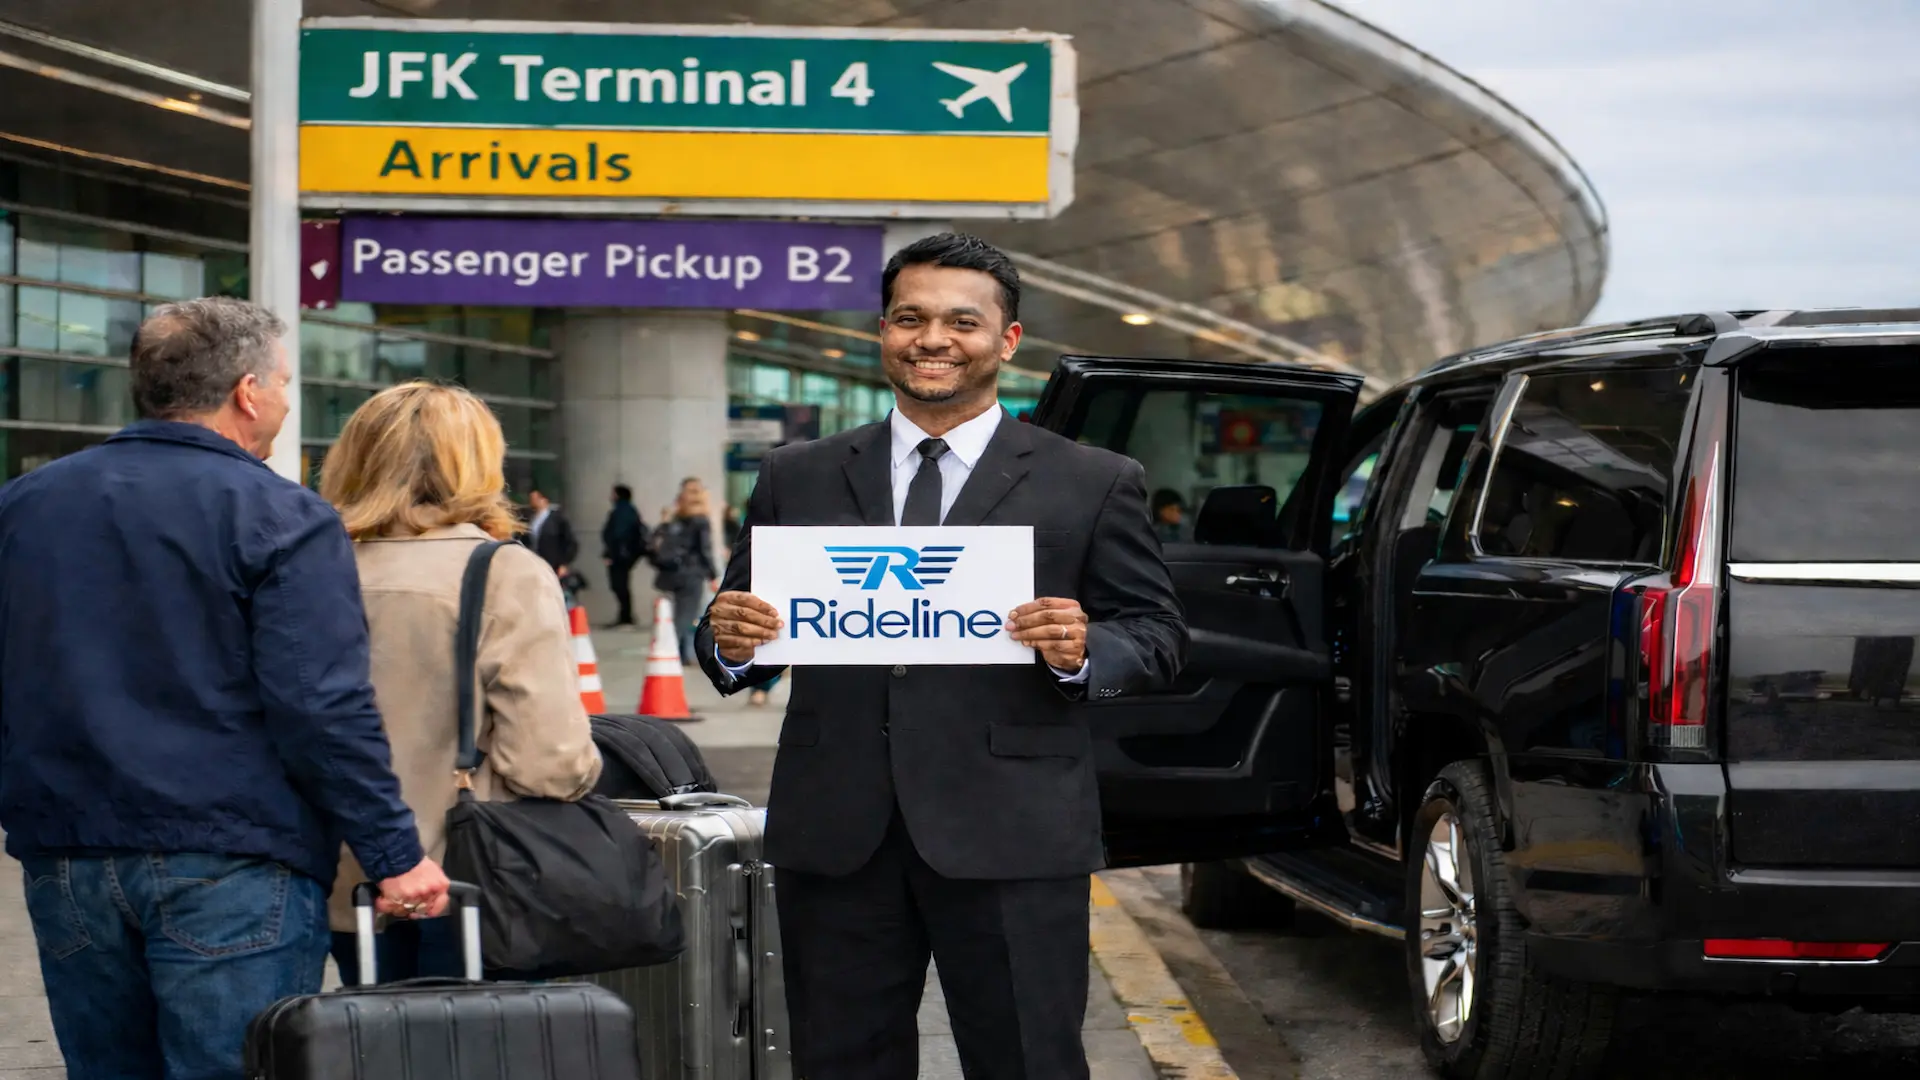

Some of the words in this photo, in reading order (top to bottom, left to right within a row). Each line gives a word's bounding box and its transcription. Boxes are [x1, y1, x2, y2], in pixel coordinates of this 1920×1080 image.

[349, 51, 478, 100] JFK
[499, 54, 806, 106] Terminal
[831, 62, 874, 107] 4
[379, 139, 632, 183] Arrivals
[353, 238, 588, 286] Passenger
[606, 244, 762, 290] Pickup
[787, 246, 853, 283] B2
[789, 597, 1003, 639] Rideline
